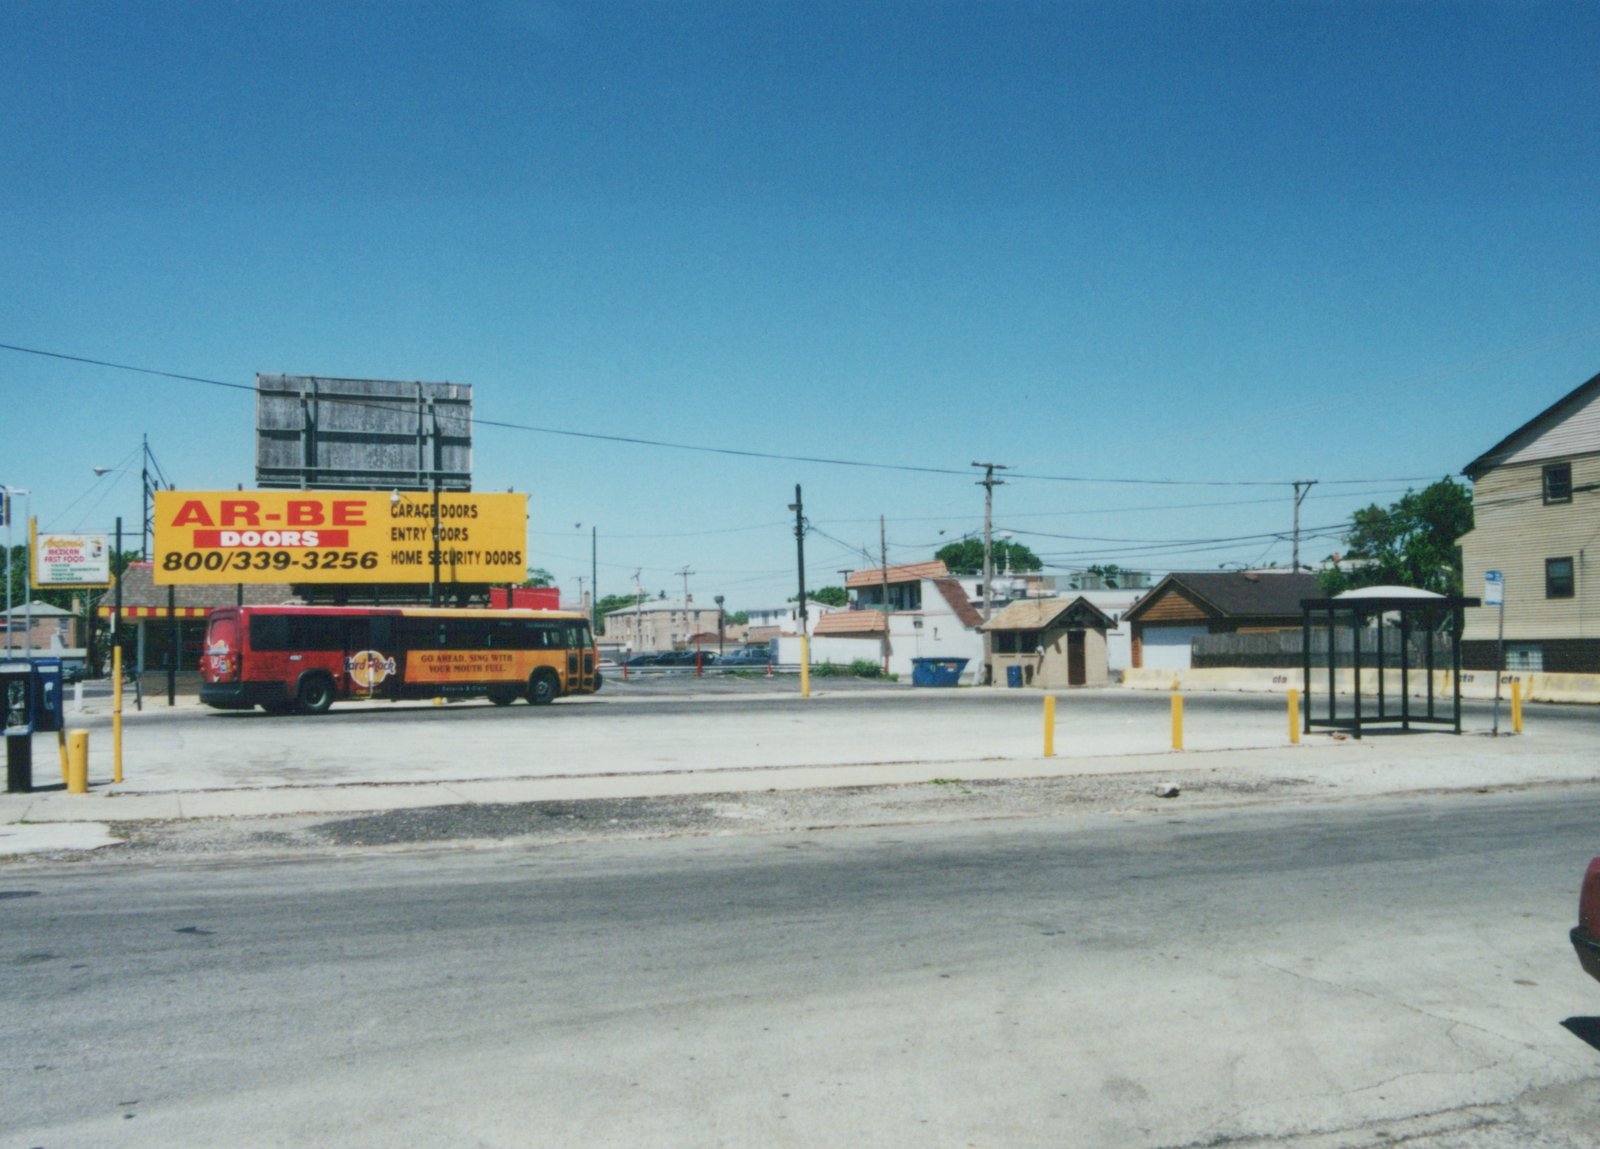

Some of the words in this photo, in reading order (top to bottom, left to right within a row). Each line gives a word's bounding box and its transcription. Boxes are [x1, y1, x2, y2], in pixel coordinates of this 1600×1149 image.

[170, 500, 368, 527] AR-BE
[390, 503, 438, 518] GARAGE
[441, 504, 478, 518] DOORS
[220, 531, 320, 547] DOORS
[391, 527, 427, 541] ENTRY
[432, 527, 469, 541] OORS
[162, 551, 379, 572] 800/339-3256
[391, 550, 422, 565] HOME
[485, 551, 522, 565] DOORS
[373, 656, 396, 675] Rock
[421, 654, 434, 663] GO
[469, 654, 488, 662] SING
[491, 654, 513, 662] WITH
[429, 664, 451, 673] YOUR
[453, 664, 482, 673] MOUTH
[1459, 673, 1474, 683] ta
